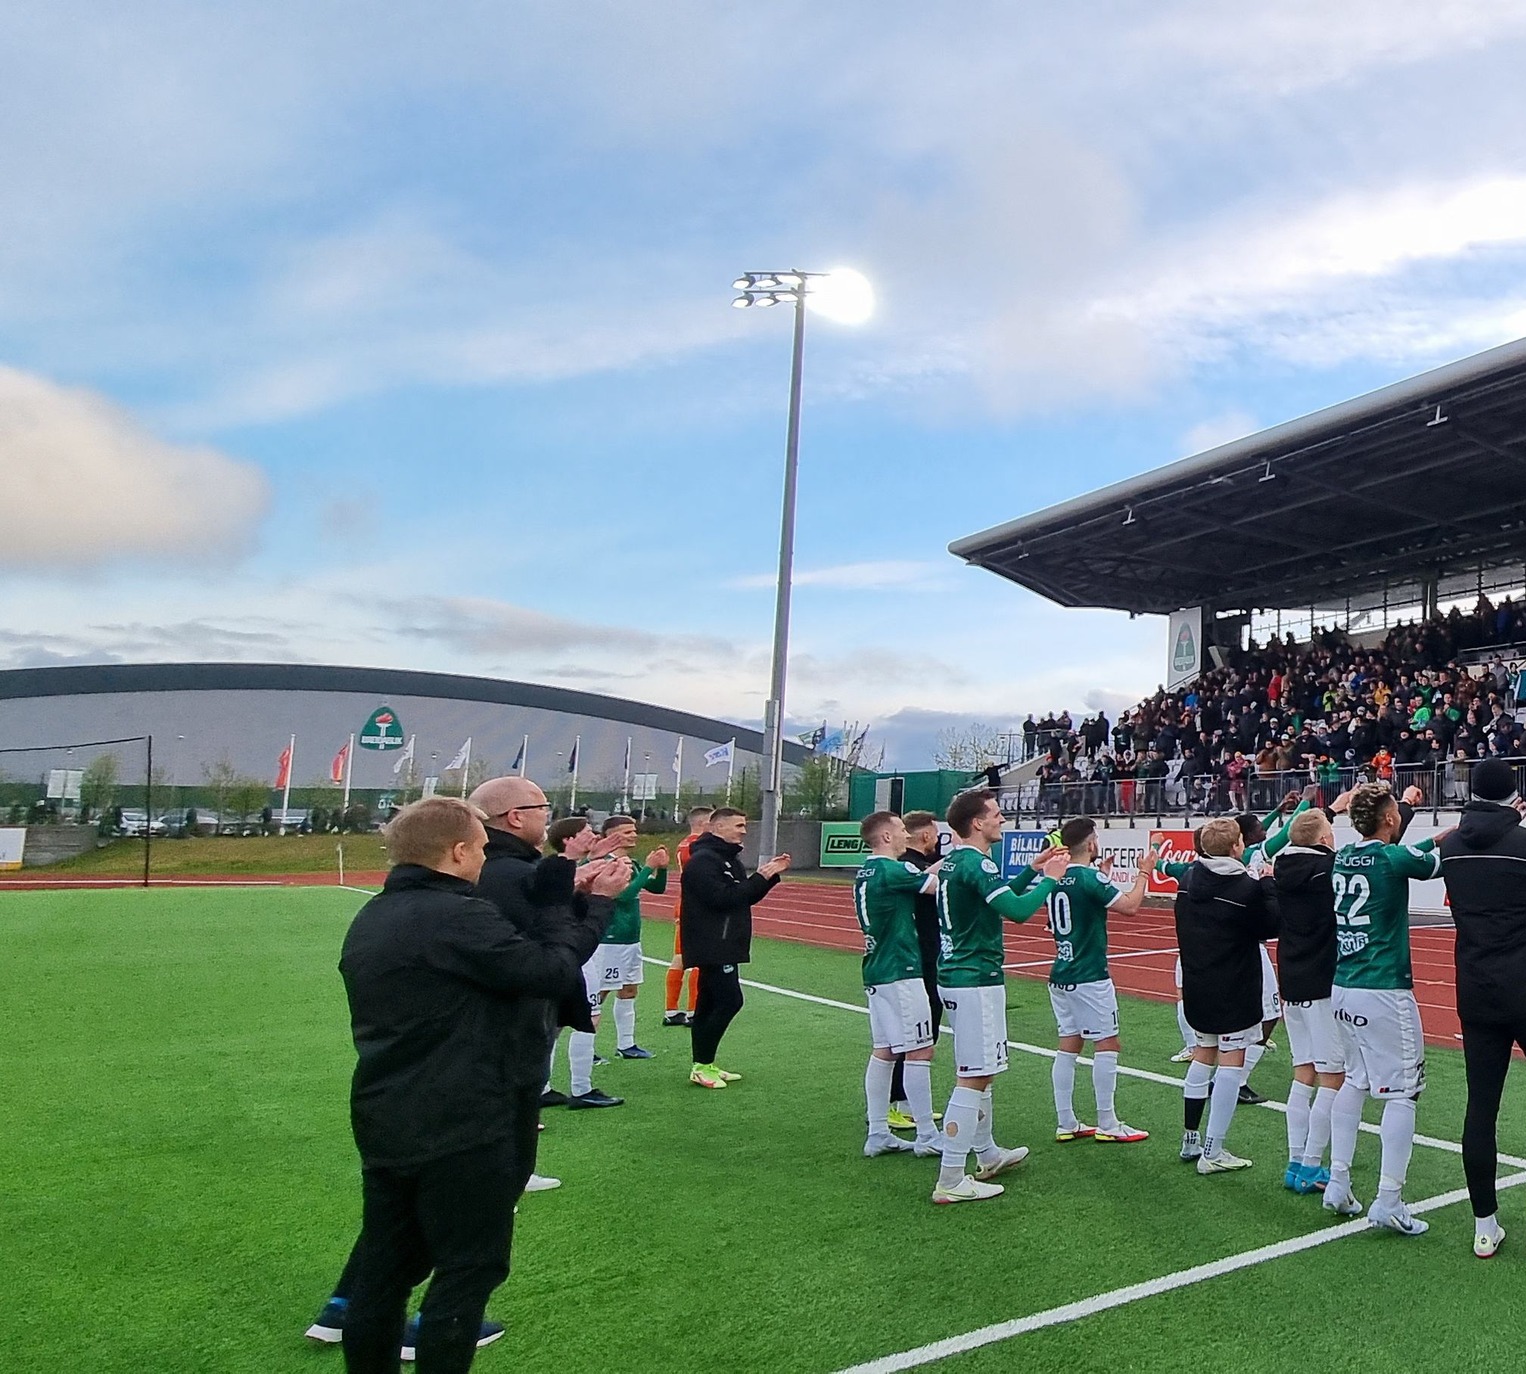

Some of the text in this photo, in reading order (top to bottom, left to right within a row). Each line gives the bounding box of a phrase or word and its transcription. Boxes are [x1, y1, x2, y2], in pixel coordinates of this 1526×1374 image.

[1009, 852, 1038, 866] AKUR
[1332, 873, 1371, 926] 22
[605, 967, 620, 979] 25
[916, 1020, 930, 1038] 11
[996, 1040, 1008, 1060] 21
